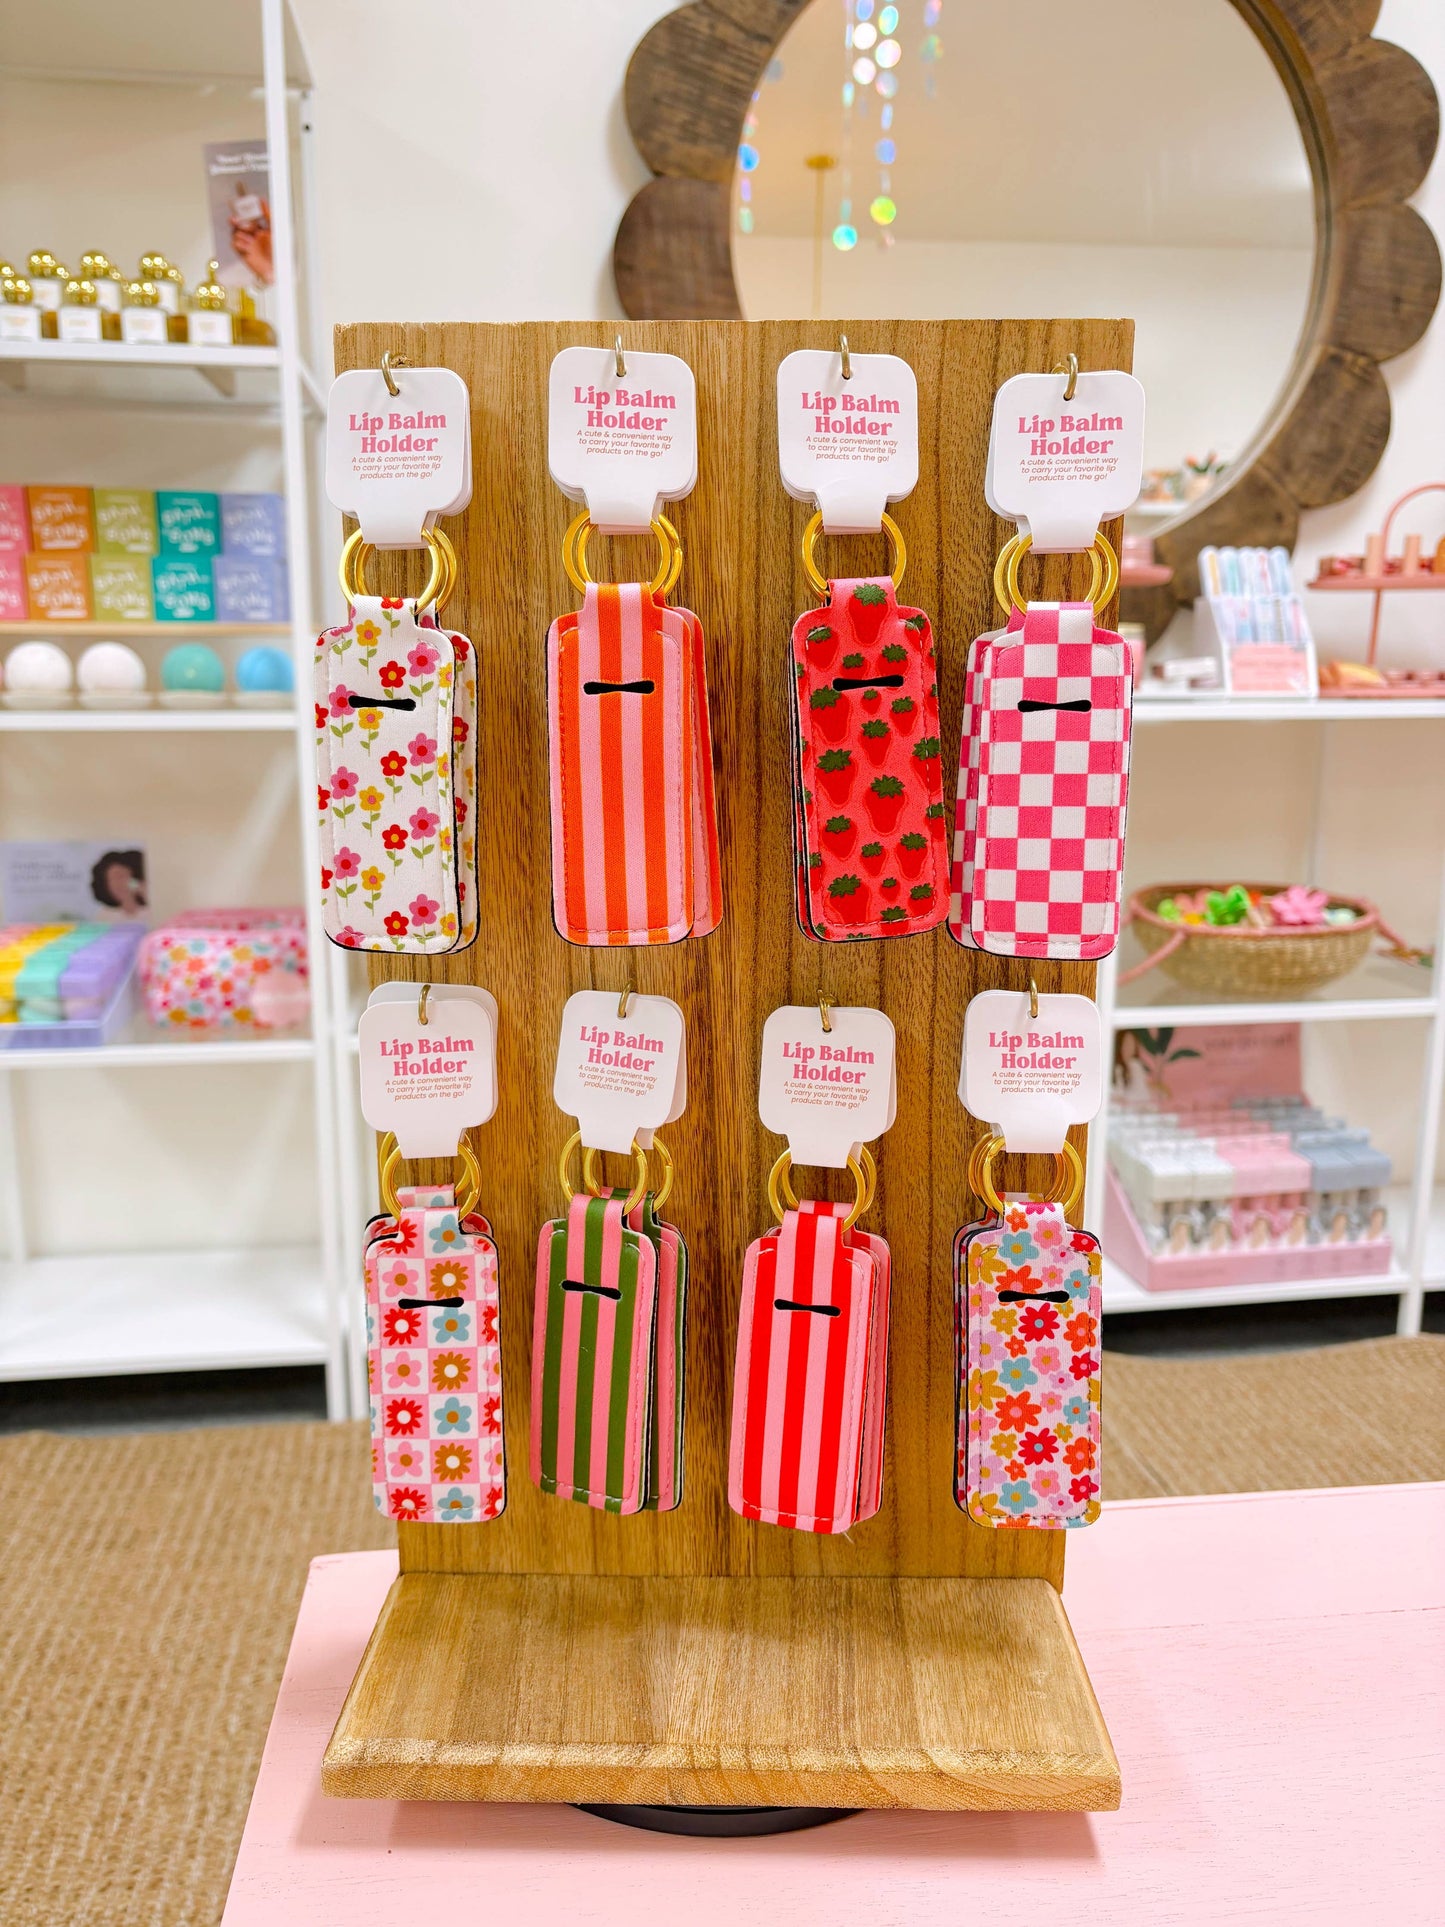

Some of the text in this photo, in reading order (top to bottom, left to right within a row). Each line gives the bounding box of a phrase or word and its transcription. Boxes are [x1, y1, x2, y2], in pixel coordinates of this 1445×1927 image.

[574, 385, 676, 410] Lip Balm
[801, 391, 900, 415] Lip Balm
[349, 410, 447, 435] Lip Balm
[587, 410, 668, 431] Holder
[815, 416, 893, 435] Holder
[1018, 412, 1123, 437] Lip Balm
[361, 434, 439, 453] Holder
[612, 432, 654, 440] convenient
[657, 435, 673, 443] way
[840, 437, 880, 445] convenient
[883, 439, 898, 447] way
[589, 439, 609, 447] carry
[630, 441, 660, 449] favorite
[661, 442, 671, 451] lip
[818, 445, 837, 453] carry
[840, 445, 855, 454] your
[858, 446, 886, 454] favorite
[887, 447, 896, 455] lip
[1031, 436, 1114, 455] Holder
[650, 450, 663, 458] go!
[816, 452, 849, 460] products
[877, 455, 889, 463] go!
[402, 462, 429, 471] favorite
[431, 462, 441, 470] lip
[1032, 466, 1052, 474] carry
[1106, 464, 1116, 473] lip
[360, 472, 393, 480] products
[421, 471, 432, 479] go!
[1029, 474, 1064, 483] products
[1094, 473, 1108, 481] go!
[580, 1026, 664, 1053] Lip Balm
[989, 1031, 1084, 1052] Lip Balm
[380, 1036, 474, 1060] Lip Balm
[783, 1042, 875, 1064] Lip Balm
[394, 1057, 467, 1076] Holder
[588, 1048, 655, 1072] Holder
[1001, 1052, 1077, 1069] Holder
[417, 1076, 457, 1084] convenient
[607, 1069, 642, 1079] convenient
[644, 1075, 657, 1083] way
[793, 1064, 866, 1084] Holder
[396, 1086, 415, 1094] carry
[417, 1085, 432, 1093] your
[434, 1083, 461, 1091] favorite
[463, 1082, 471, 1090] lip
[584, 1080, 613, 1091] products
[624, 1086, 635, 1094] the
[636, 1087, 647, 1097] go!
[621, 1078, 645, 1087] favorite
[646, 1082, 655, 1090] lip
[815, 1084, 854, 1092] convenient
[856, 1087, 870, 1095] way
[1071, 1079, 1080, 1087] lip
[394, 1092, 426, 1102] products
[453, 1091, 465, 1099] go!
[794, 1089, 812, 1097] carry
[831, 1092, 857, 1100] favorite
[859, 1094, 868, 1103] lip
[1001, 1086, 1034, 1094] products
[1061, 1087, 1073, 1095] go!
[791, 1097, 822, 1105] products
[848, 1100, 860, 1109] go!
